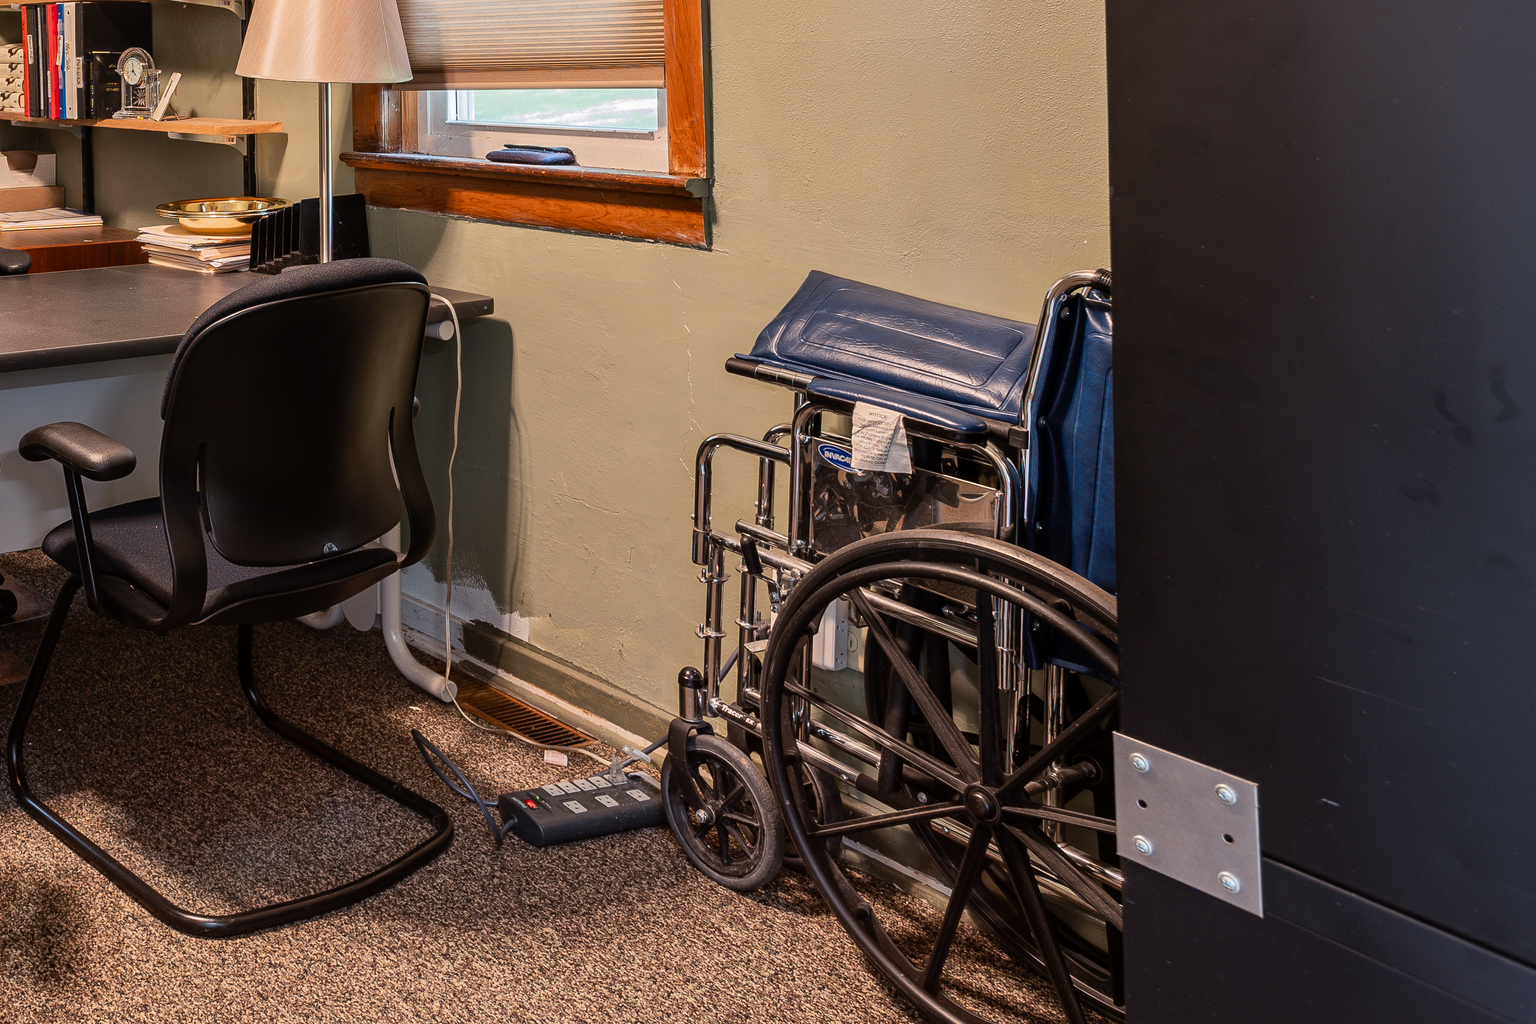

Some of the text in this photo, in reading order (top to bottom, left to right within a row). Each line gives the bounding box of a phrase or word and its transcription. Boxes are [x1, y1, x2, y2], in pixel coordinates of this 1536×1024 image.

[869, 411, 888, 419] NOTICE
[721, 704, 755, 726] Tracer EX
